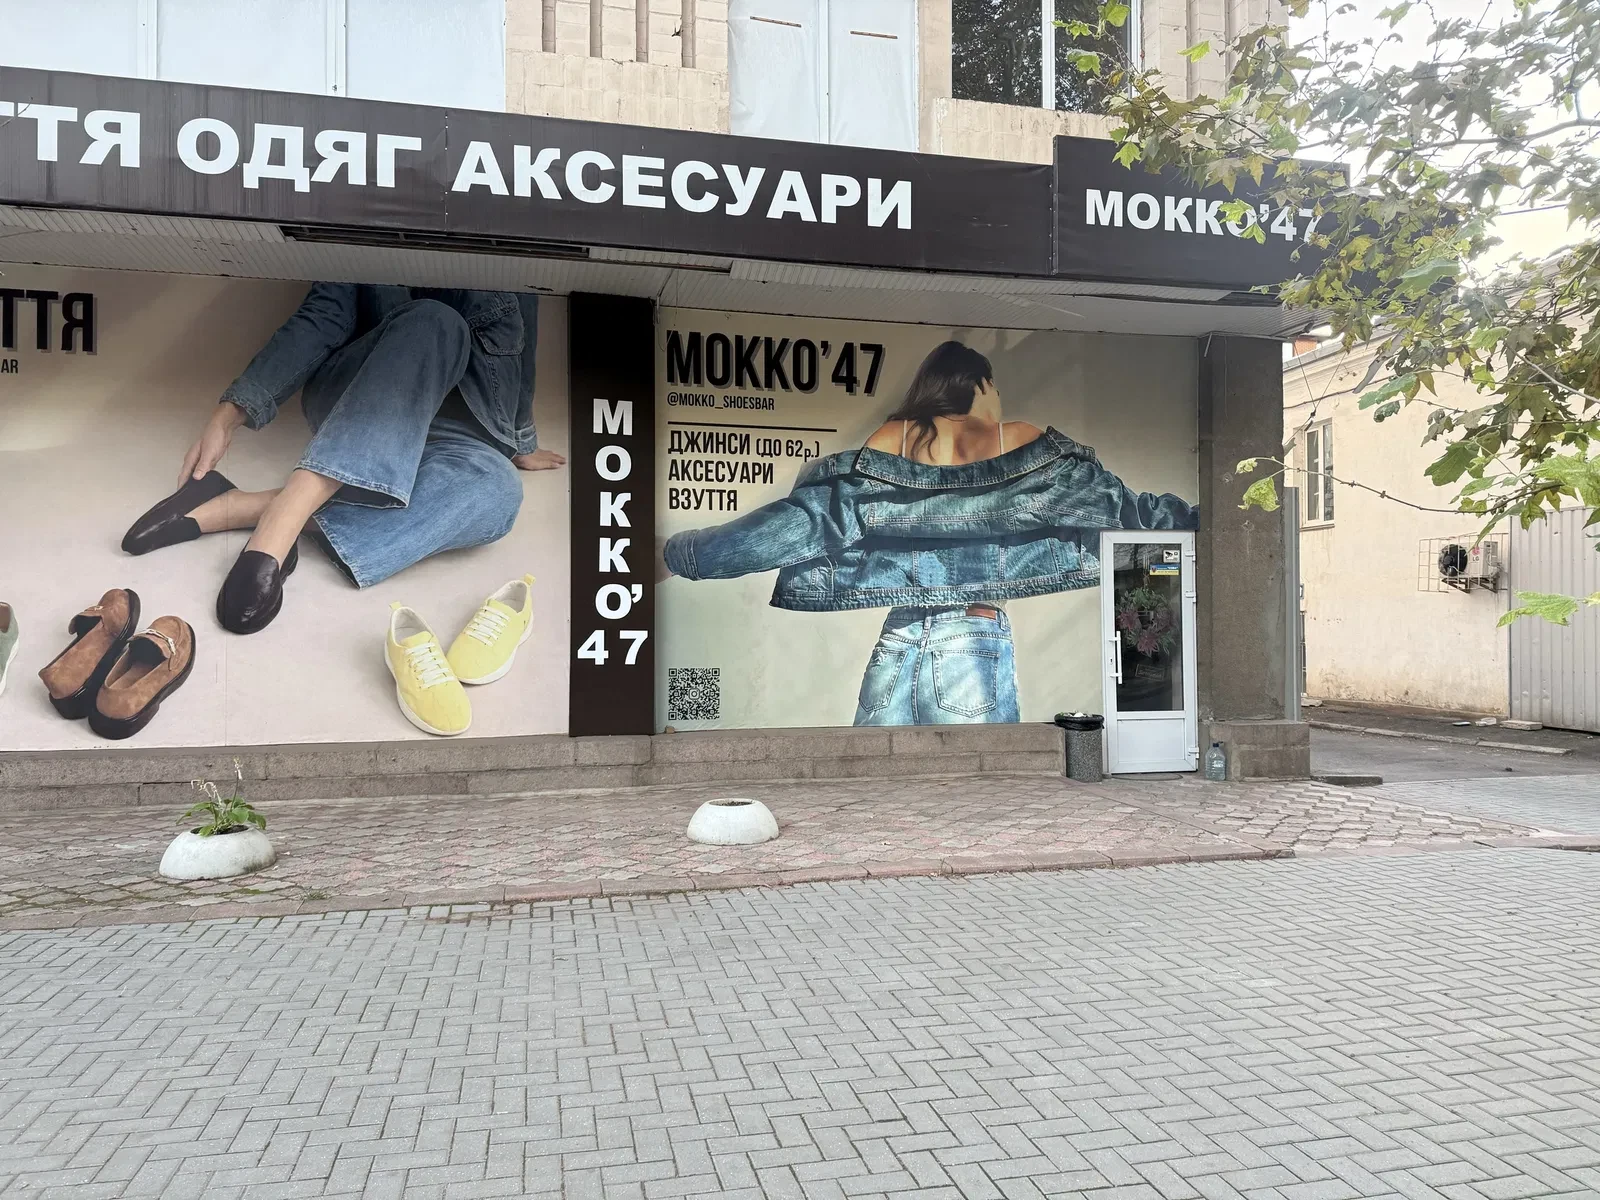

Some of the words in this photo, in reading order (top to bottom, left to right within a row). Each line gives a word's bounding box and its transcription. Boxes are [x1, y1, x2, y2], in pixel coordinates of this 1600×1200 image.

[176, 117, 423, 193] ОДЯГ
[451, 140, 913, 230] АКСЕСУАРИ
[667, 392, 775, 411] @MOKKO_SHOESBAR
[668, 430, 751, 455] ДЖИНСИ
[755, 438, 782, 458] (ДО
[668, 459, 774, 485] АКСЕСУАРИ
[668, 487, 738, 512] ВЗУТТЯ
